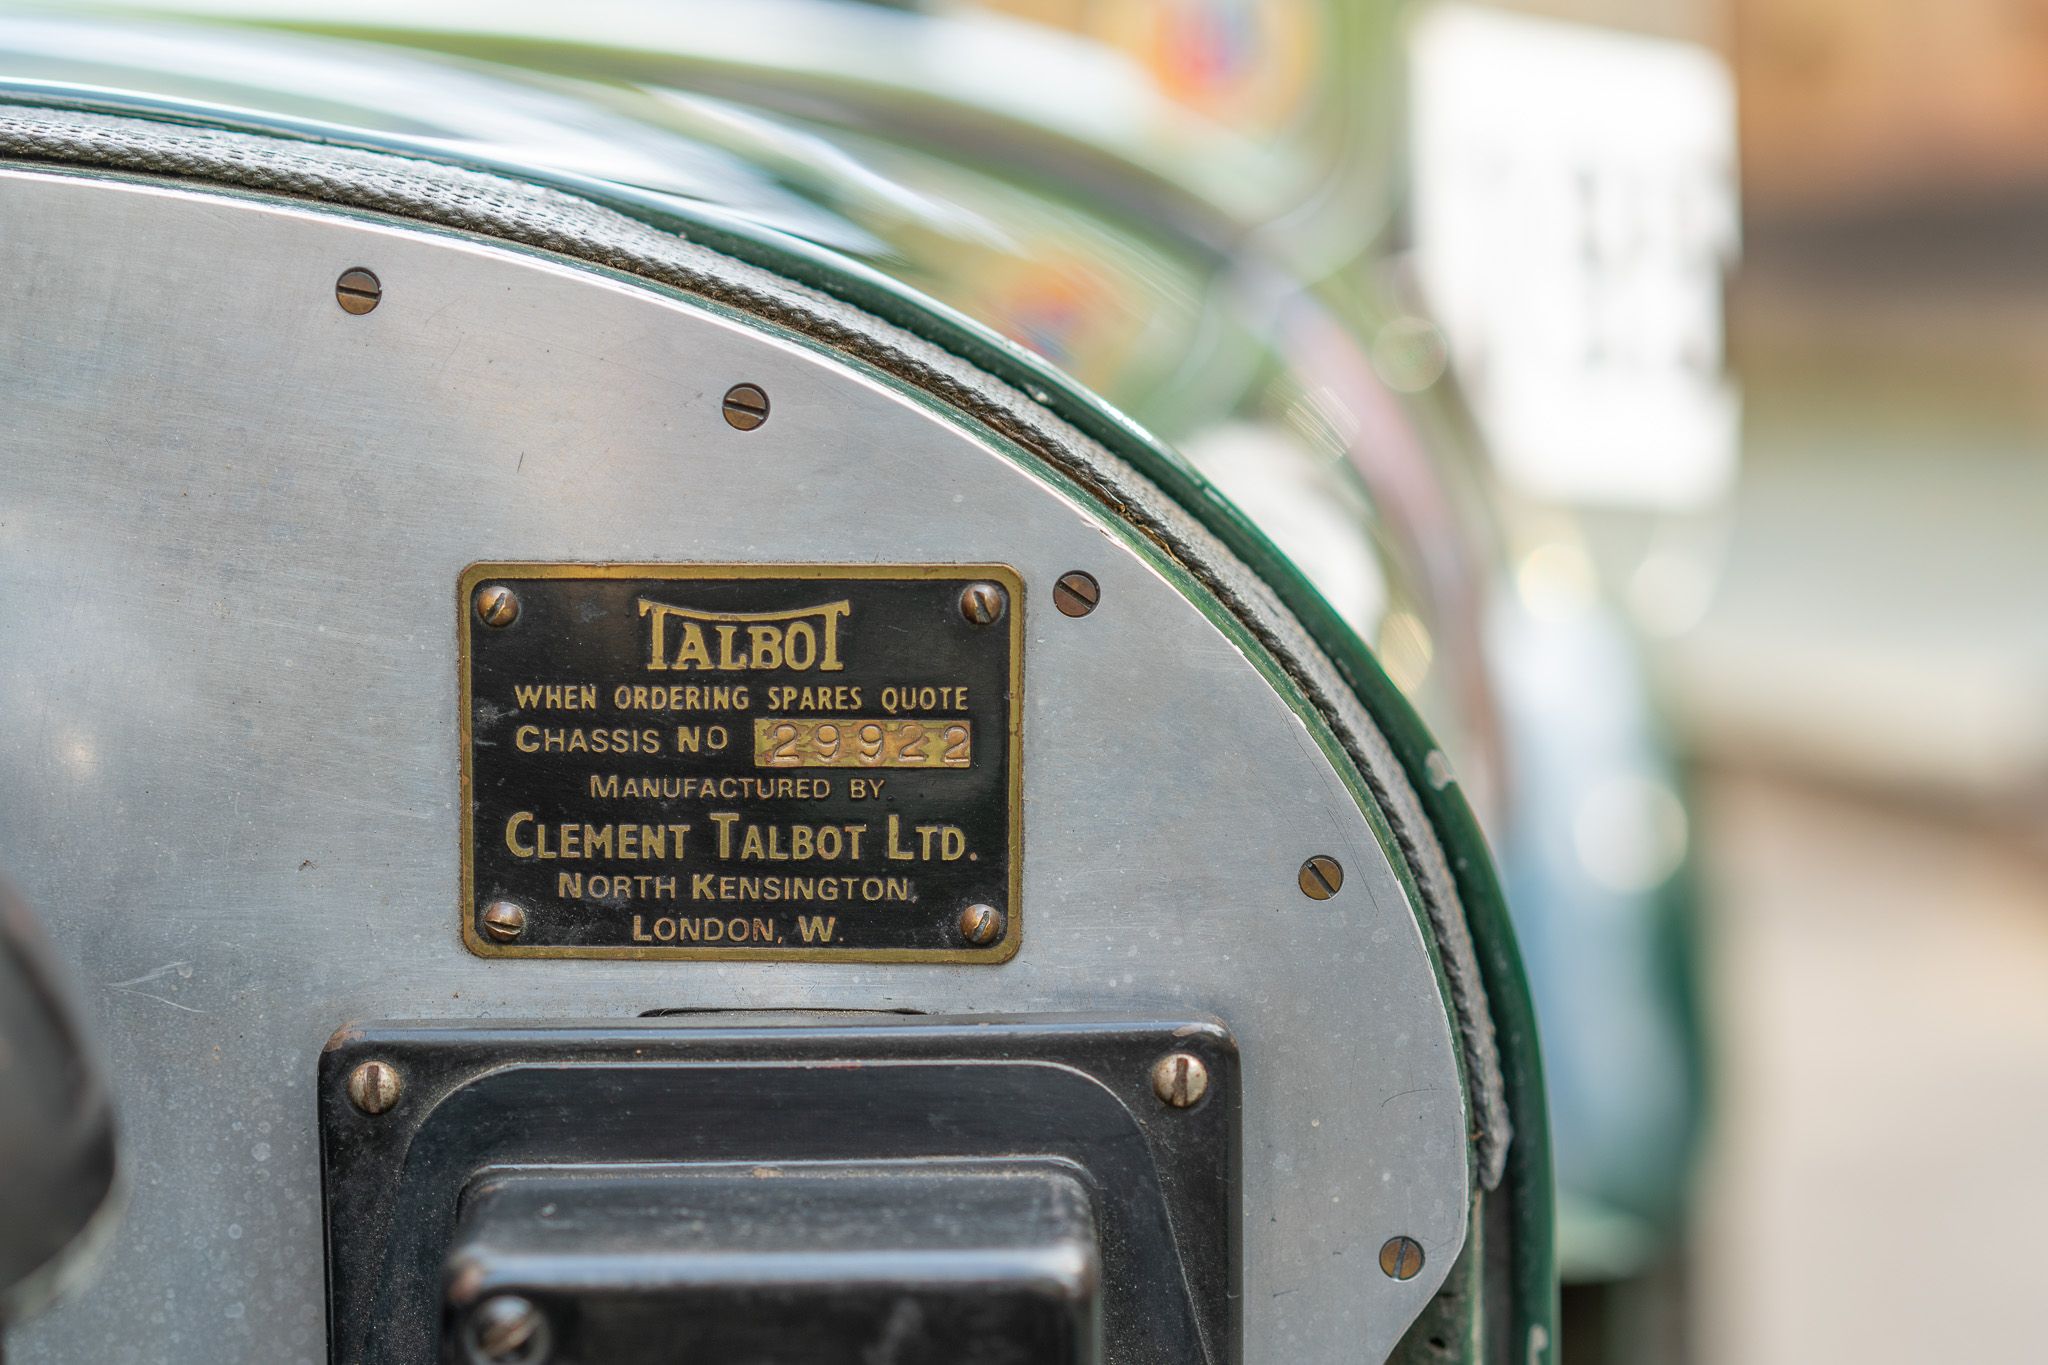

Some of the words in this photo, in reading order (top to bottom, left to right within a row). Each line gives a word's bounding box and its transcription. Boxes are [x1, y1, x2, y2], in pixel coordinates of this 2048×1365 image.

[638, 599, 850, 671] TALBOT
[514, 685, 596, 710] WHEN
[614, 686, 749, 711] ORDERING
[768, 686, 862, 711] SPARES
[881, 686, 969, 713] QUOTE
[516, 725, 659, 753] CHASSIS
[678, 725, 728, 753] NO
[771, 724, 970, 763] 29922
[590, 775, 831, 800] MANUFACTURED
[850, 778, 886, 800] BY
[506, 812, 691, 860] CLEMENT
[710, 812, 867, 860] TALBOT
[888, 814, 977, 862] LTD.
[558, 872, 676, 899] NORTH
[633, 916, 782, 945] LONDON,
[799, 917, 844, 943] W.
